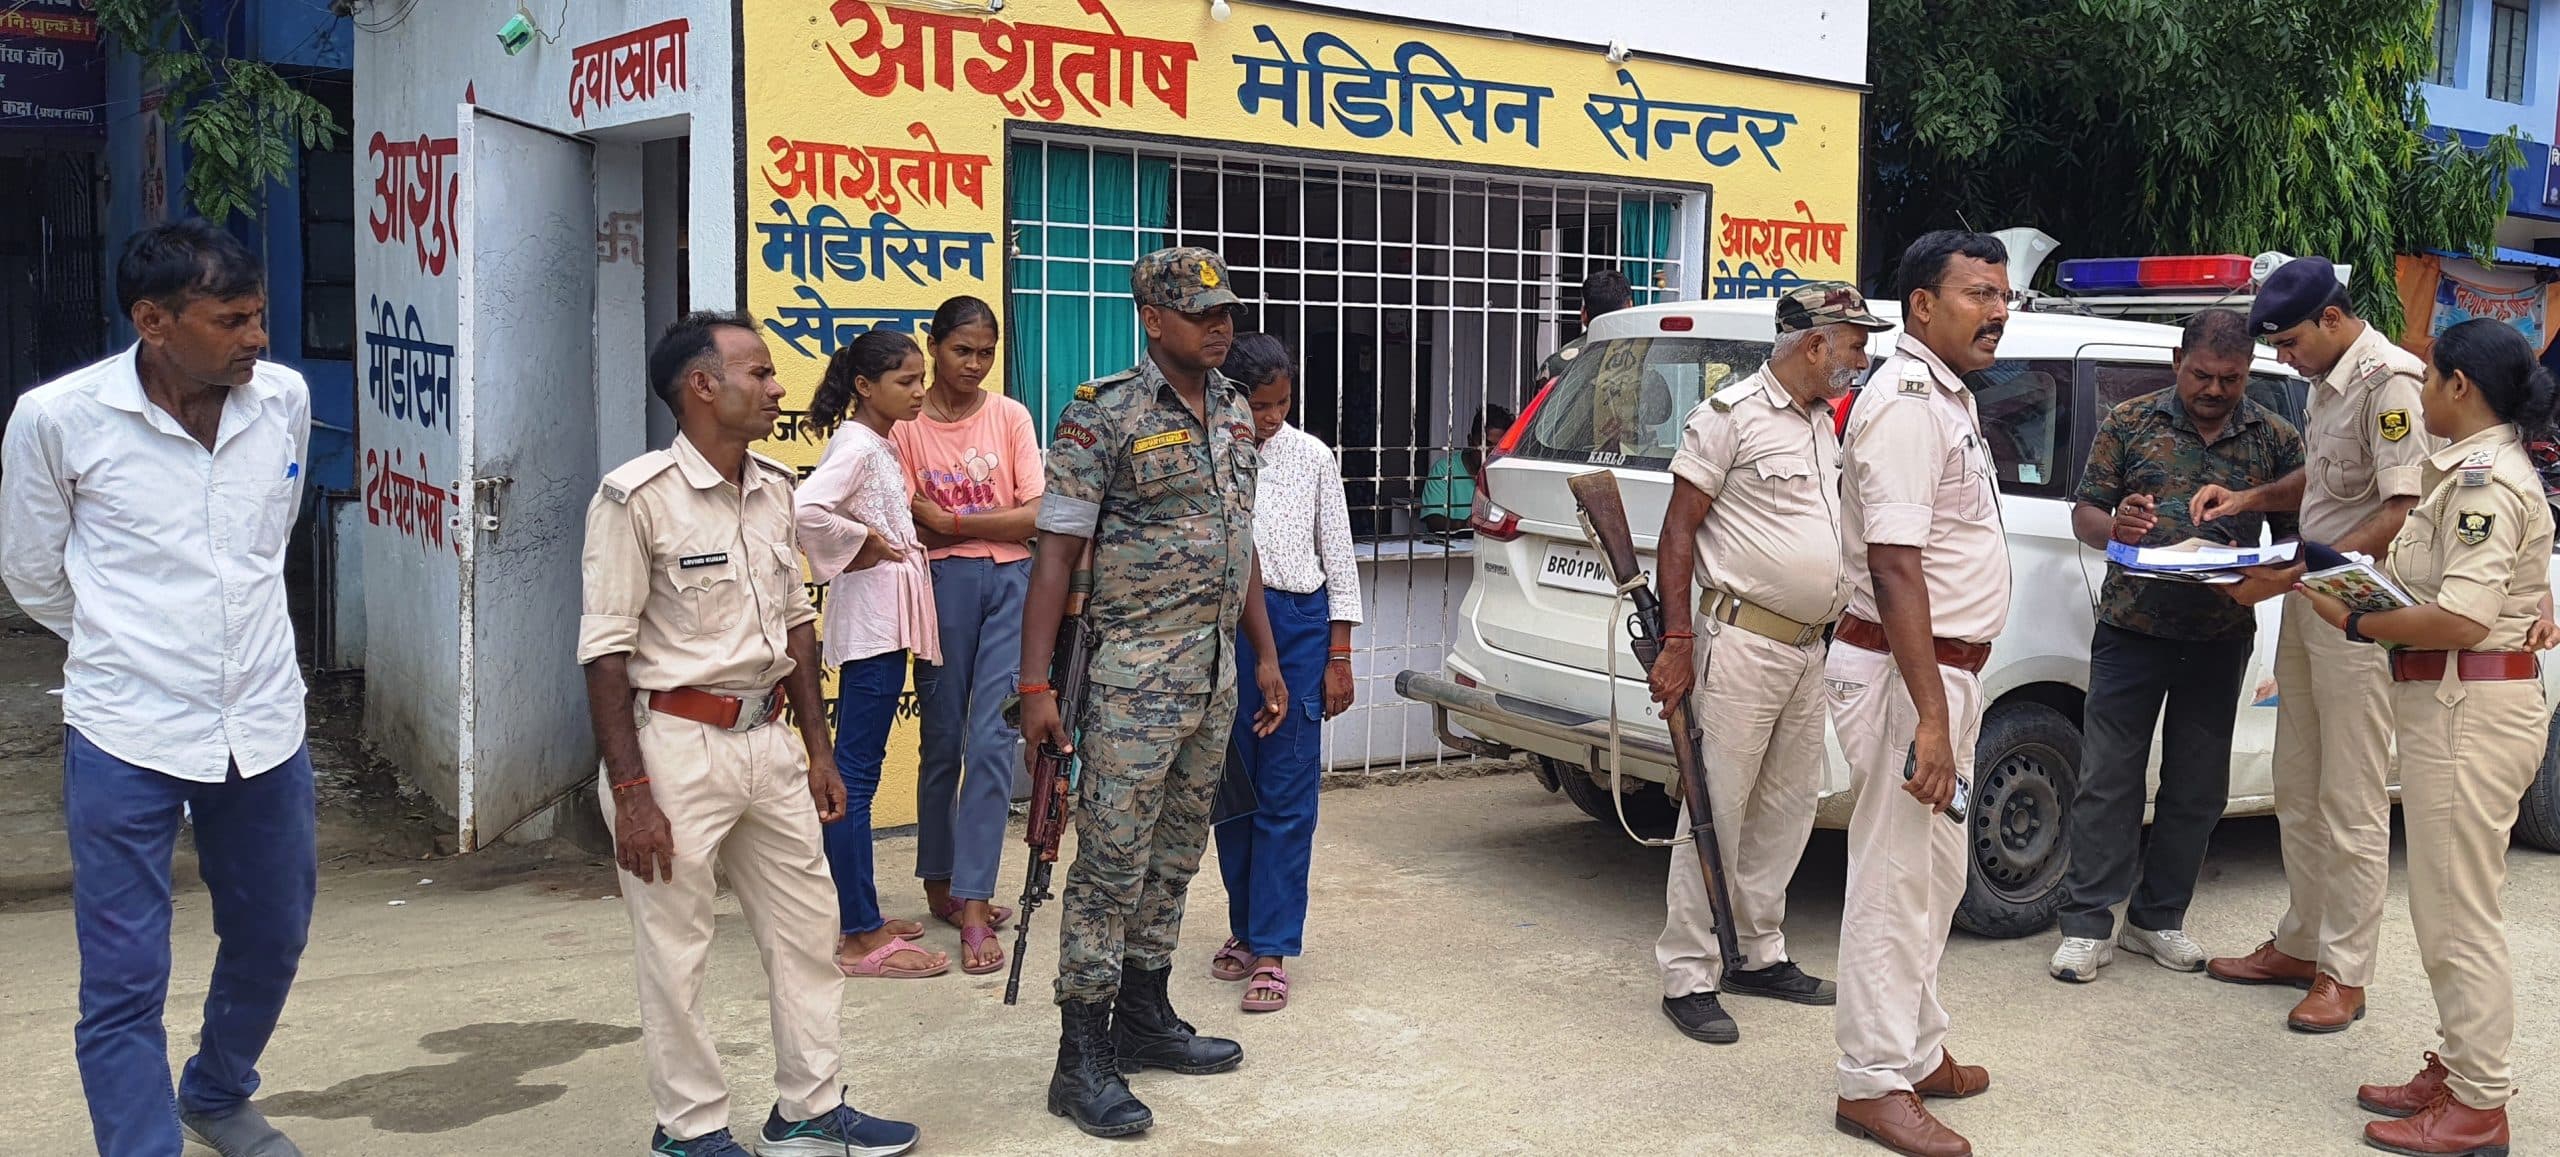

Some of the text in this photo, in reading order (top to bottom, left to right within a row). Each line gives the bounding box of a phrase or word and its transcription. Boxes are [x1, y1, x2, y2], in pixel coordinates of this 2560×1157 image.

[569, 18, 689, 127] दवाखाना
[826, 0, 1797, 171] आशुतोष मेडिसिन सेन्टर
[369, 131, 459, 276] आशु
[762, 122, 992, 213] आशुतोष
[755, 199, 995, 286] मेडिसिन
[1718, 200, 1848, 268] आशुतोष
[366, 293, 454, 436] मेडिसिन
